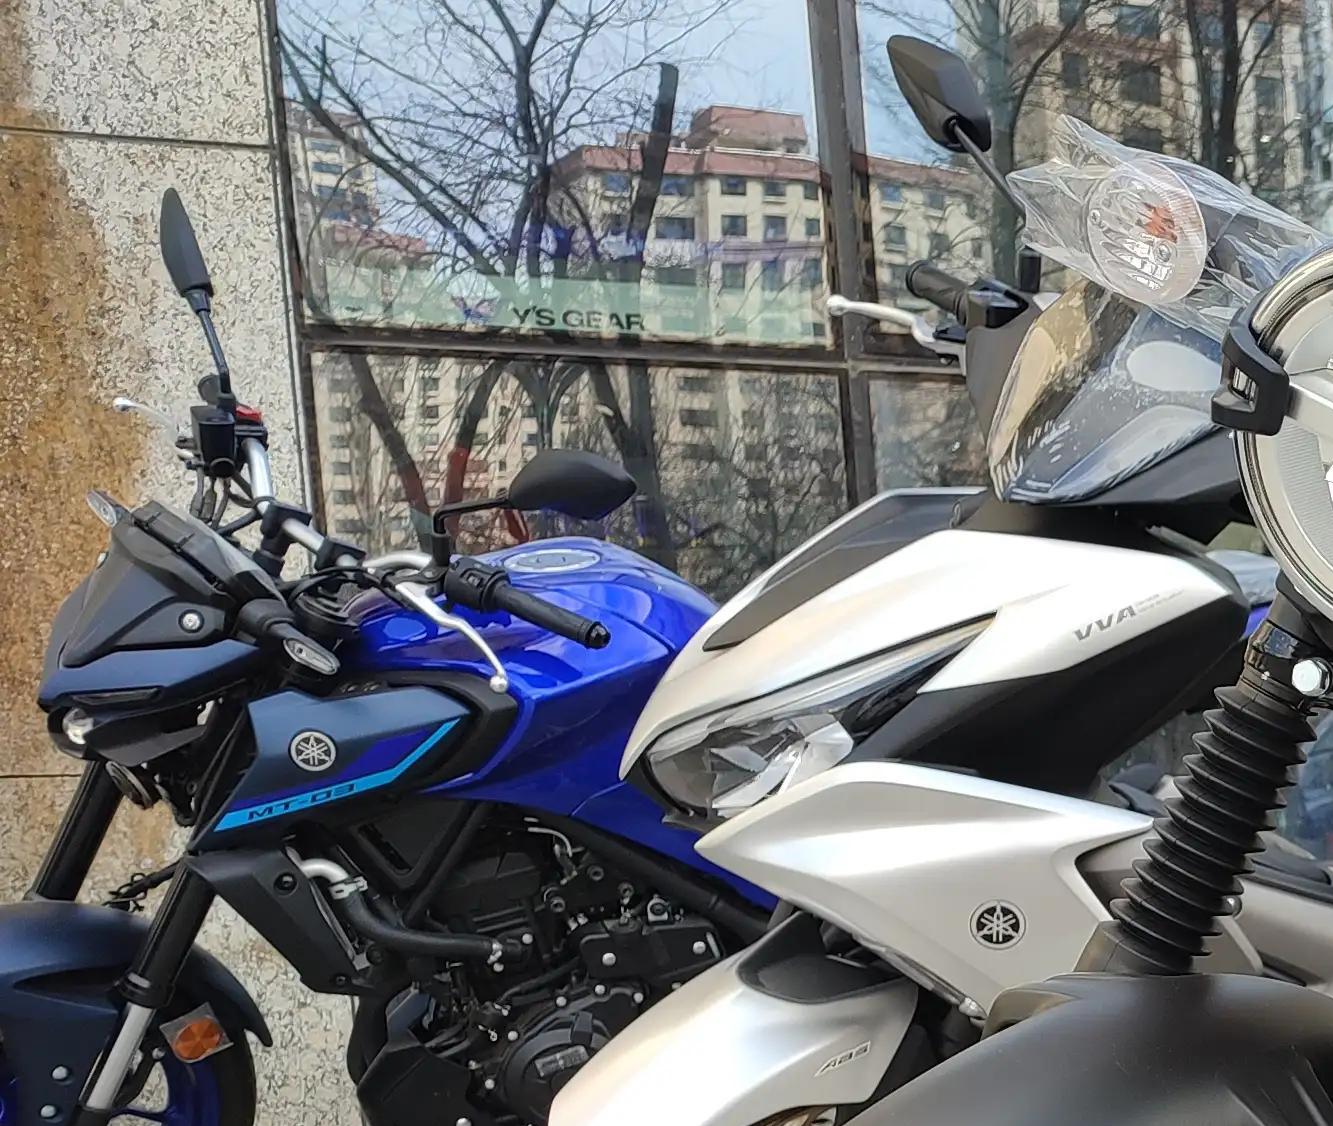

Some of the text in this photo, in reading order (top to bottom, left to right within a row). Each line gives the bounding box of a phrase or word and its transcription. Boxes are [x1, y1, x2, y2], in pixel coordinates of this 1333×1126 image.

[513, 305, 645, 331] Y'S GEAR
[1072, 604, 1136, 642] VVA
[247, 783, 355, 820] MT-03
